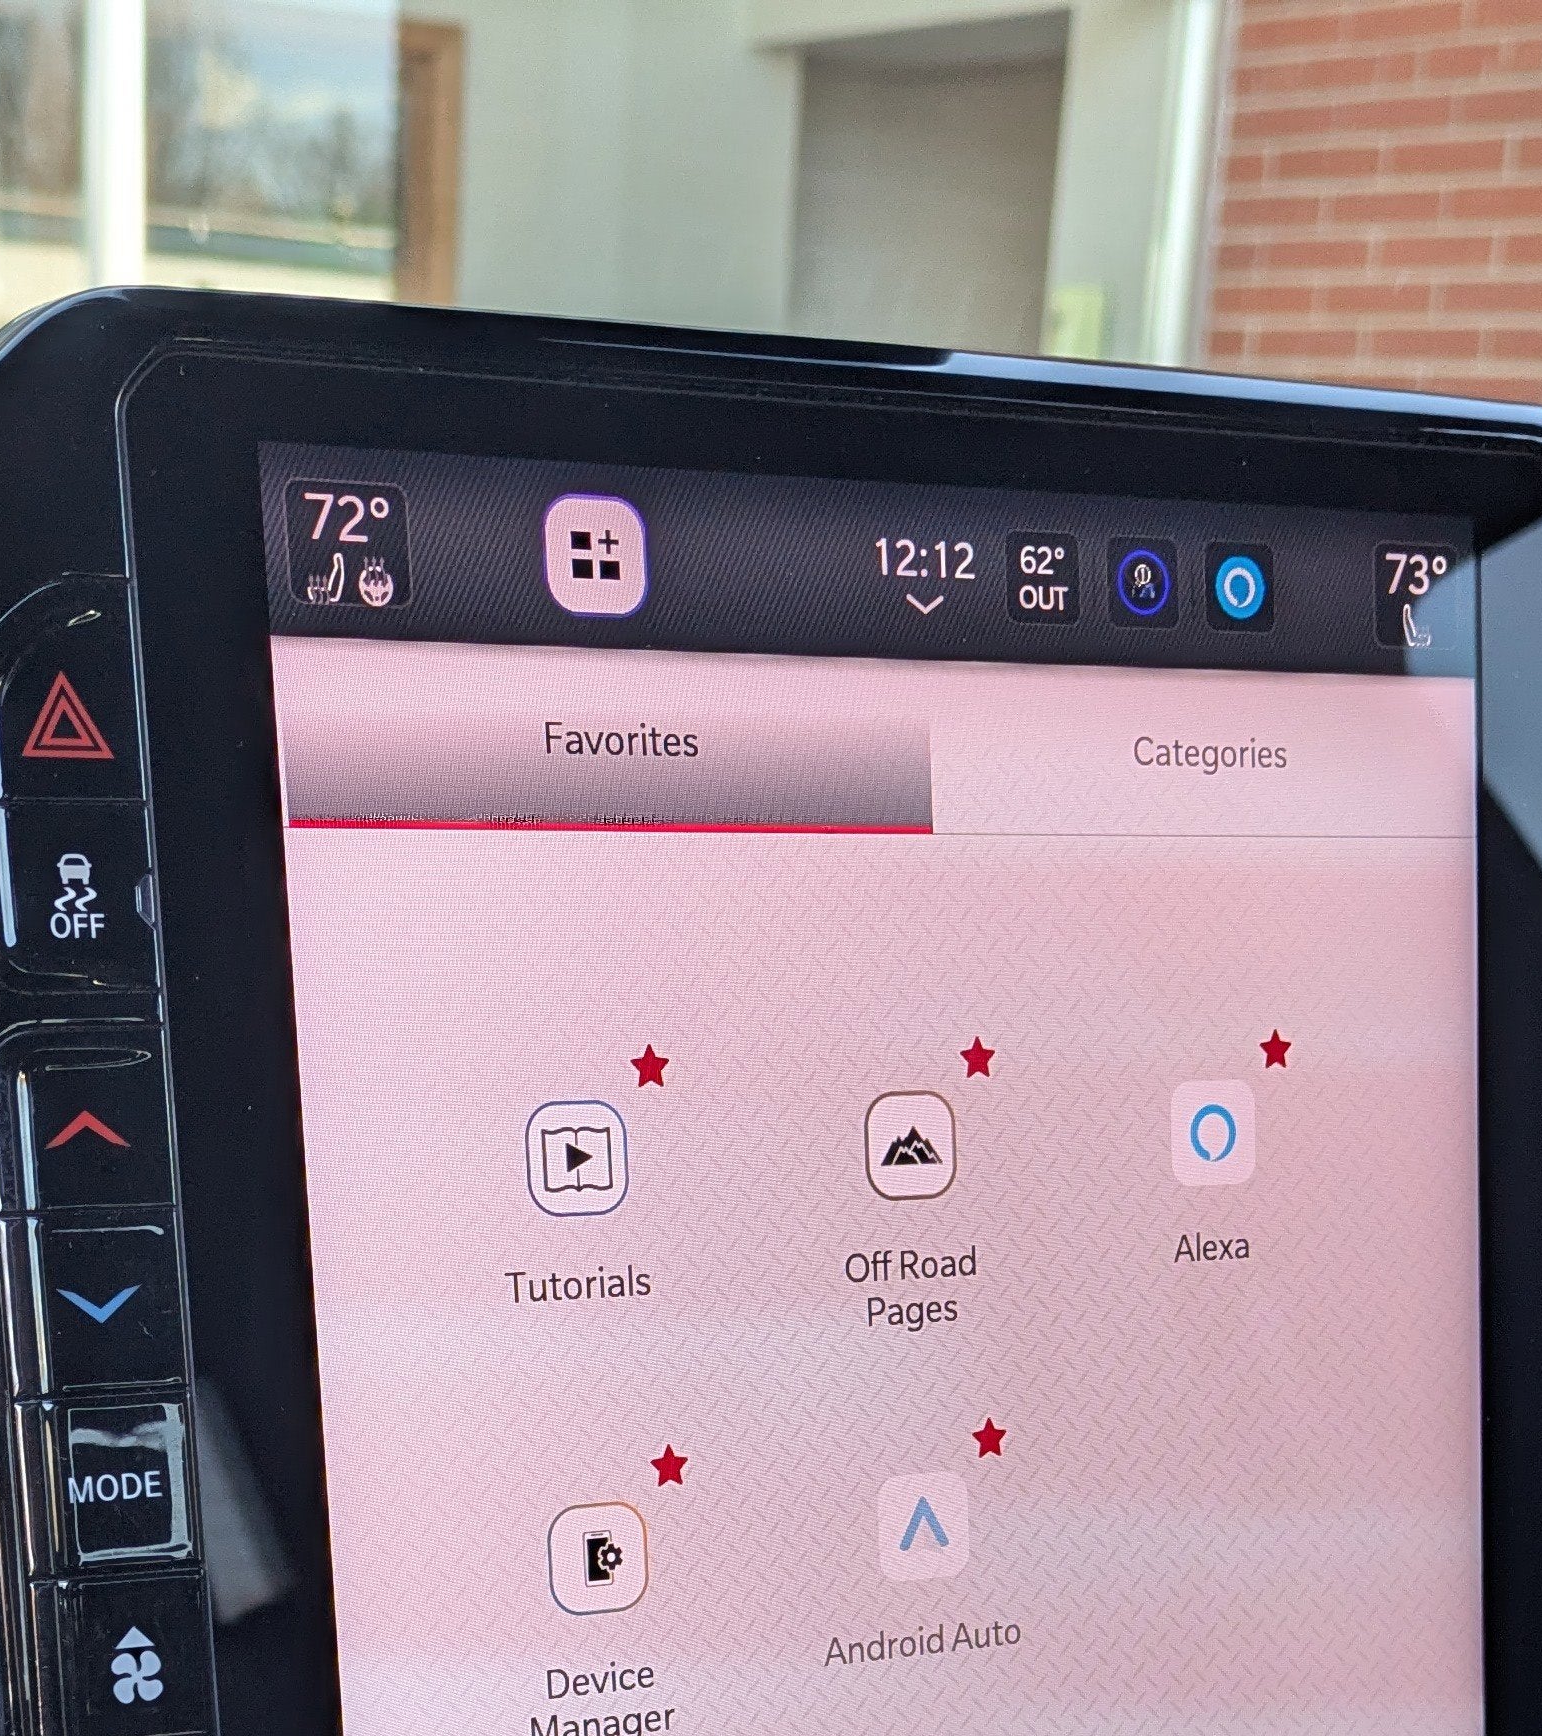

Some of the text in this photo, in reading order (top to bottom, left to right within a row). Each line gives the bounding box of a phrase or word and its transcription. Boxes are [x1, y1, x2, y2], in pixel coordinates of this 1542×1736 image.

[303, 492, 390, 543] 72°
[874, 537, 977, 582] 12:12
[1019, 545, 1066, 577] 62°
[1384, 552, 1449, 596] 73°
[1018, 584, 1069, 614] OUT
[544, 721, 700, 758] Favorites
[1132, 736, 1289, 776] Categories
[49, 912, 106, 940] OFF
[844, 1245, 978, 1283] Off Road
[1174, 1233, 1251, 1263] Alexa
[504, 1264, 652, 1305] Tutorials
[866, 1296, 959, 1333] Pages
[67, 1469, 164, 1505] MODE
[824, 1618, 1022, 1667] Android Auto
[545, 1661, 656, 1701] Device
